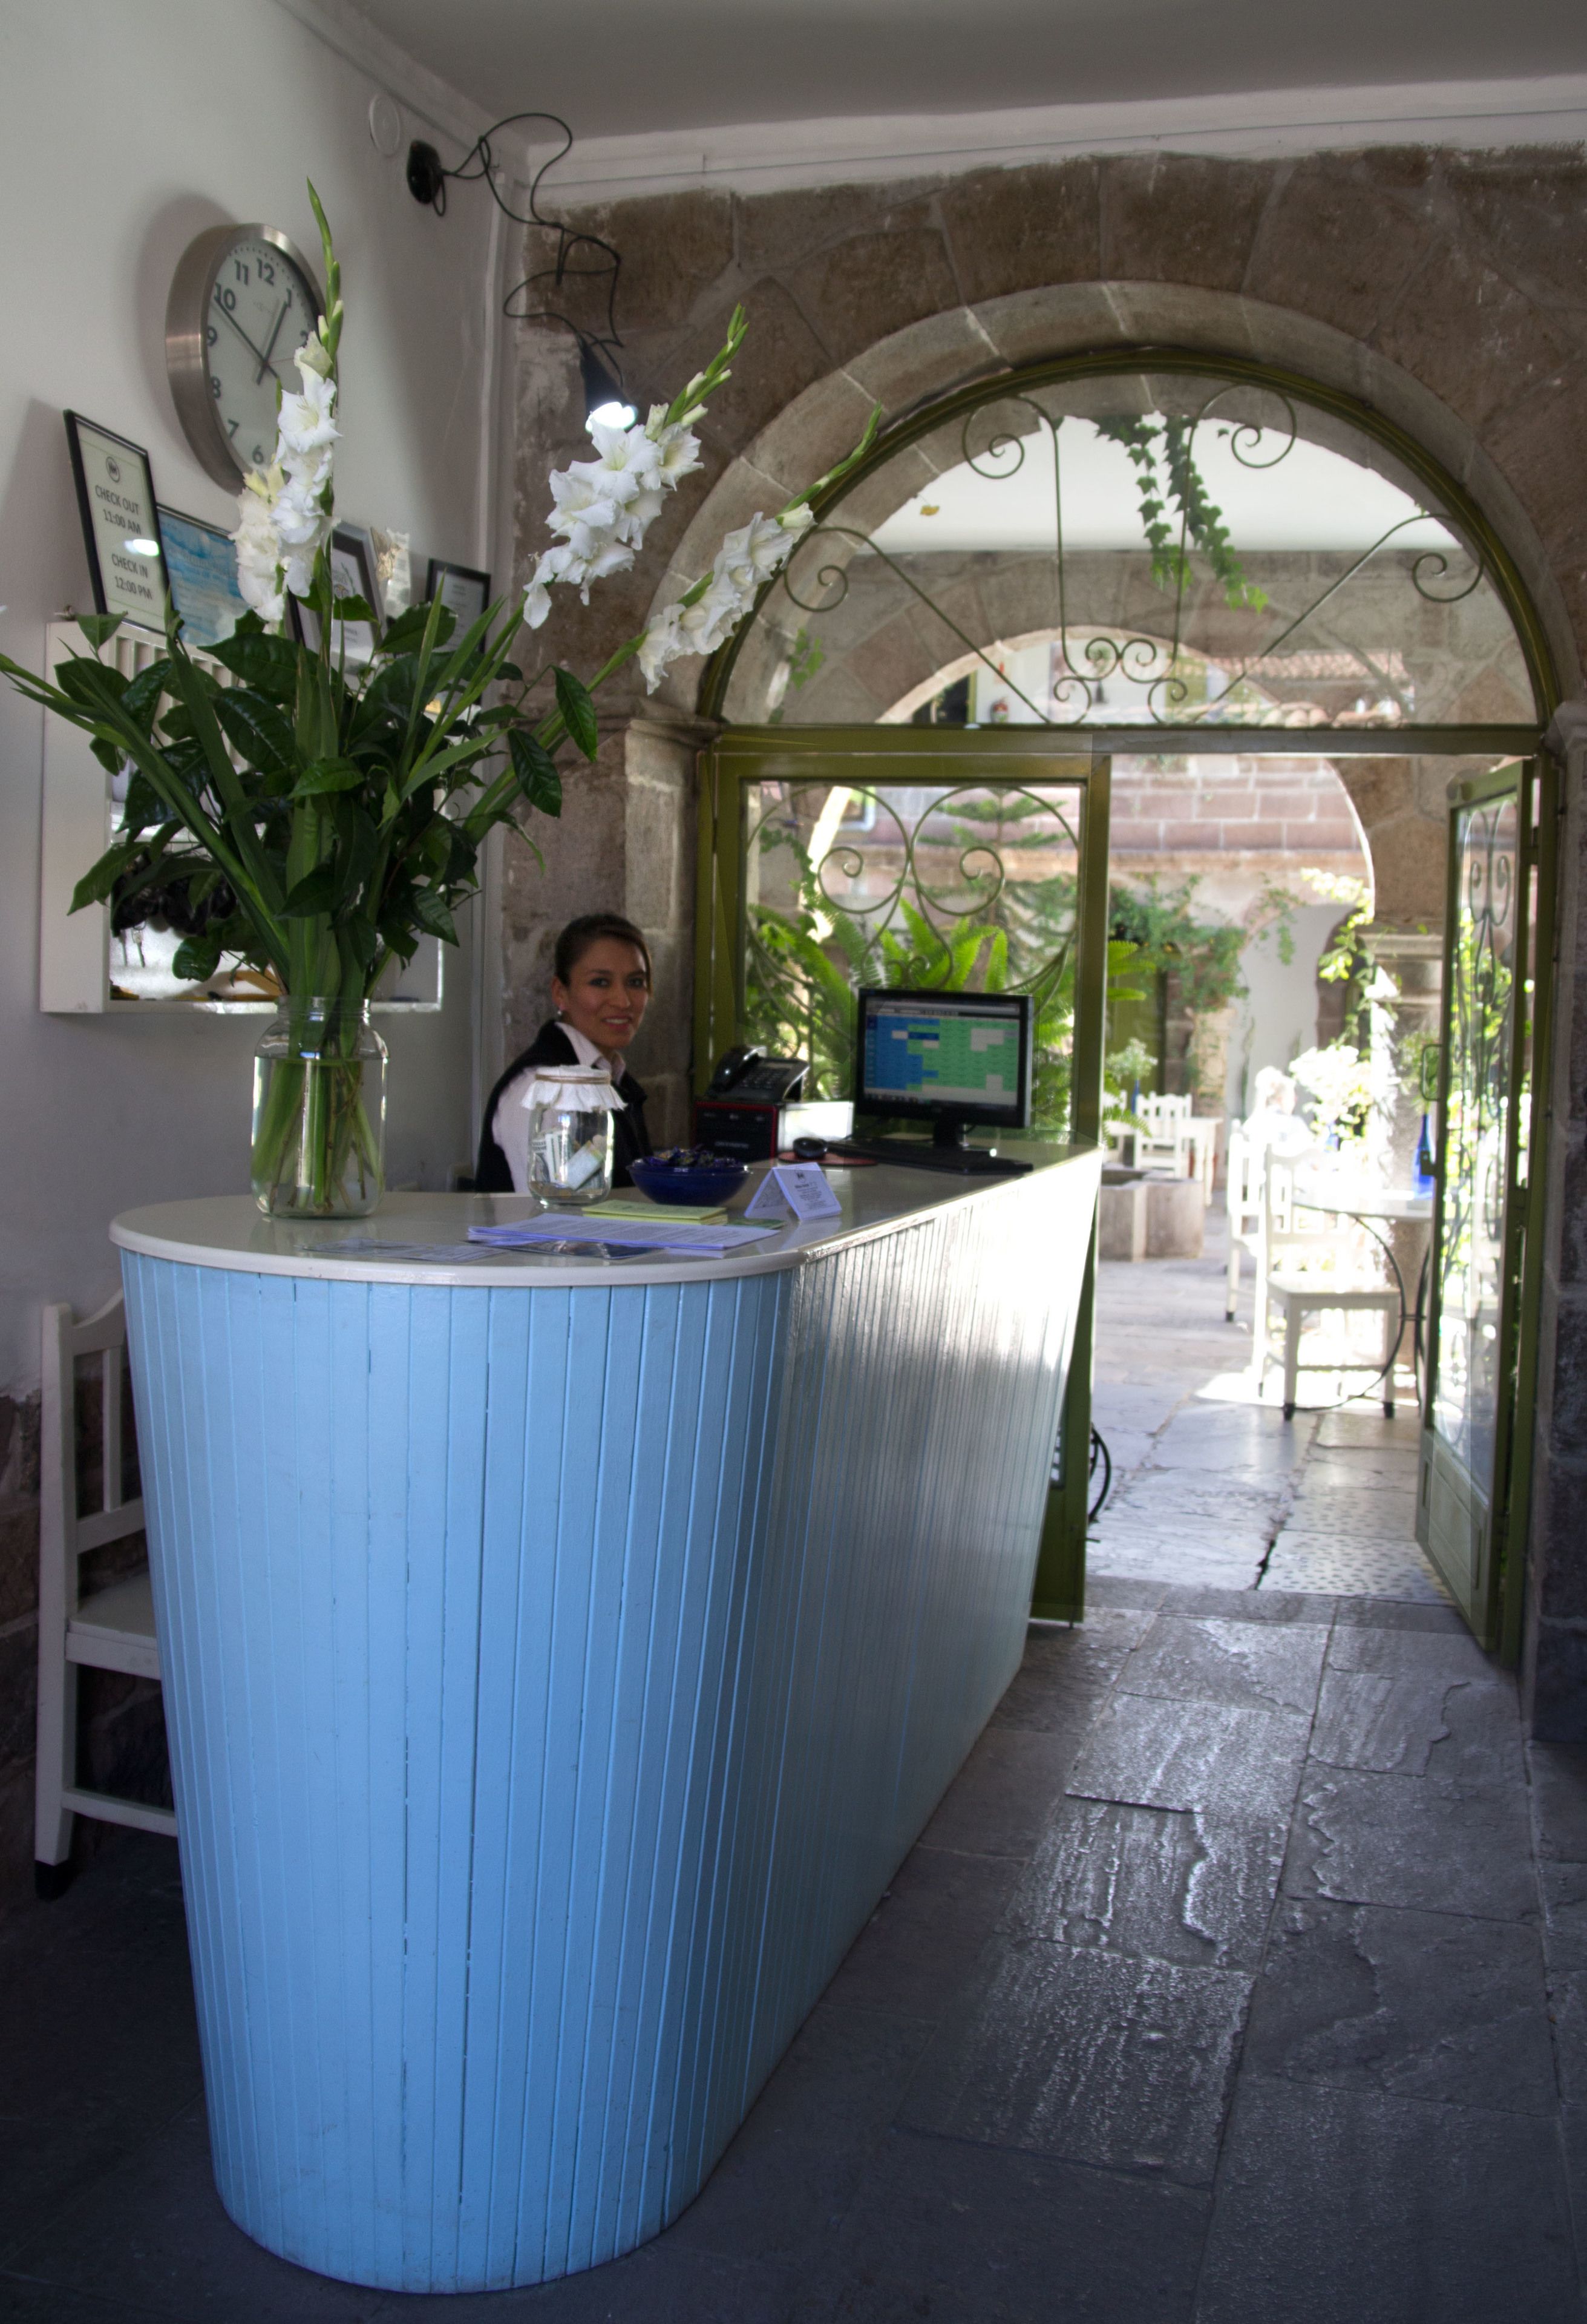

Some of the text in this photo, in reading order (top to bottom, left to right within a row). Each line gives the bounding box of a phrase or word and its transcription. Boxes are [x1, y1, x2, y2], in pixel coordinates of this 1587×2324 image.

[234, 259, 249, 286] 11
[257, 257, 274, 286] 12
[215, 282, 236, 310] 10
[286, 287, 292, 308] 1
[207, 326, 218, 347] 9
[211, 375, 221, 398] 8
[227, 419, 240, 438] 7
[252, 444, 264, 465] 6
[95, 485, 139, 515] CHECK OUT
[103, 509, 142, 536] 11:00 AM
[111, 553, 148, 578] CHECK IN
[114, 576, 152, 600] 12:00 PM
